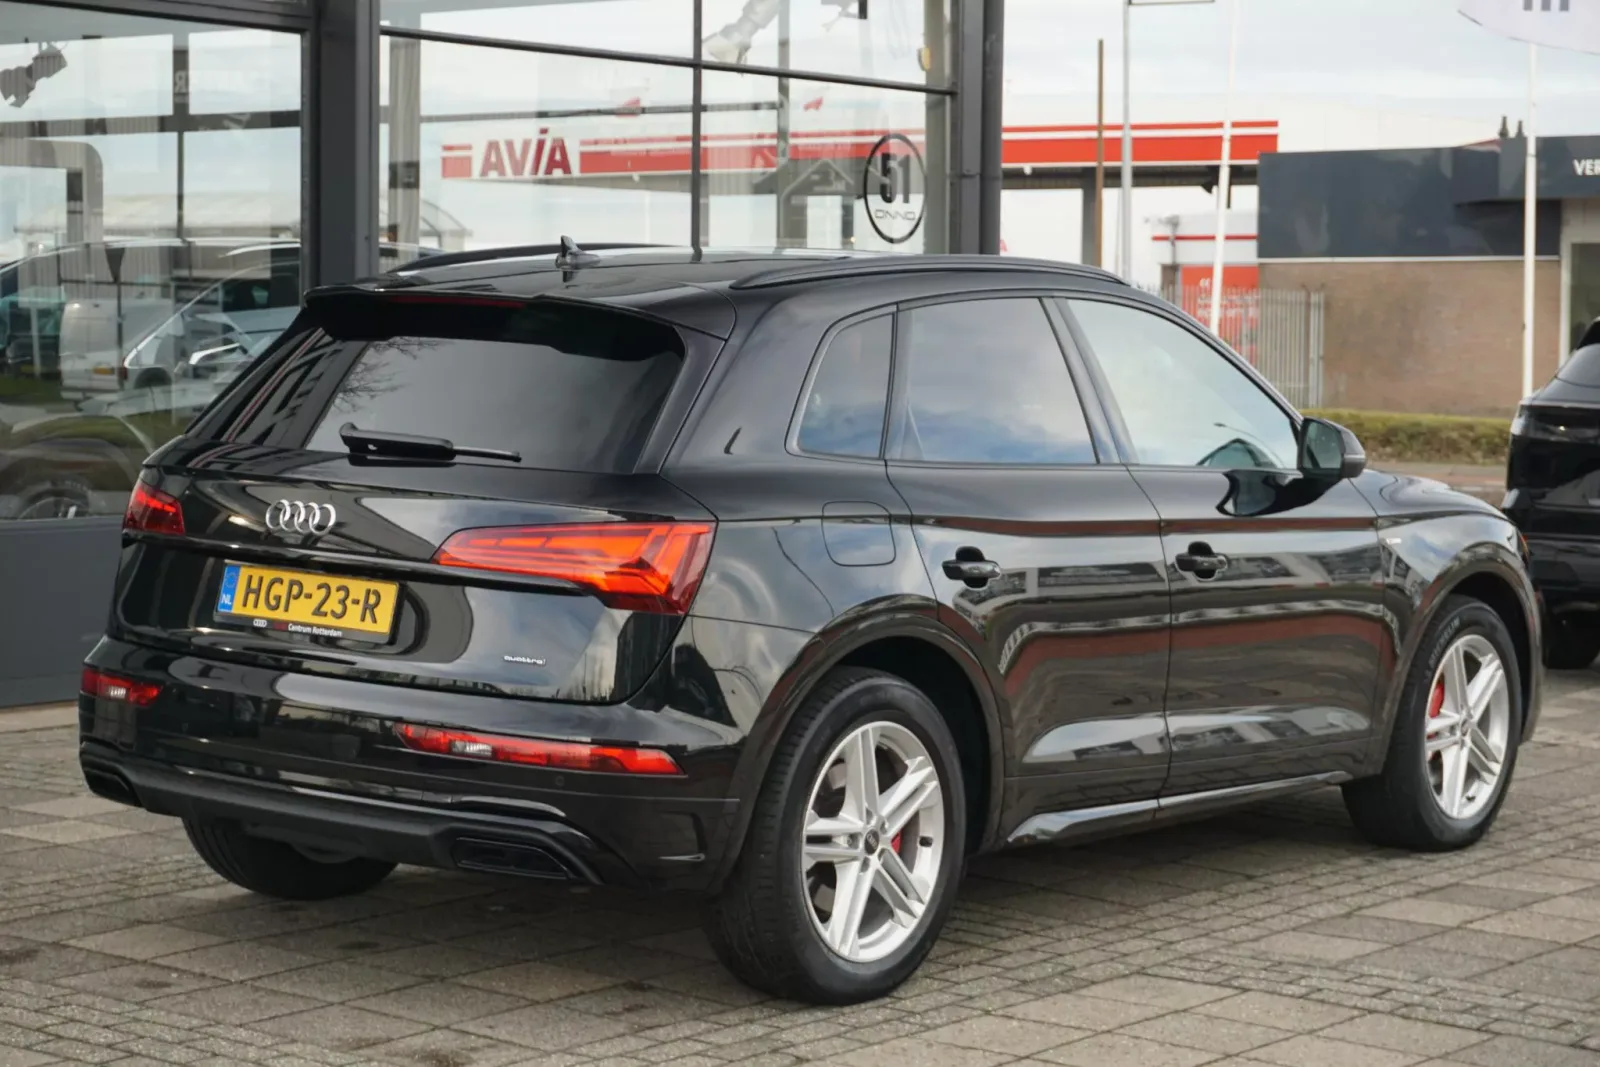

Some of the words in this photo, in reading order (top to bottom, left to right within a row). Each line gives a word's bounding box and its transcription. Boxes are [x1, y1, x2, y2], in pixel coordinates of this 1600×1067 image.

[221, 593, 232, 606] NL
[242, 574, 382, 624] HGP-23-R
[288, 623, 312, 634] Centrum
[312, 626, 343, 637] Rotterdam
